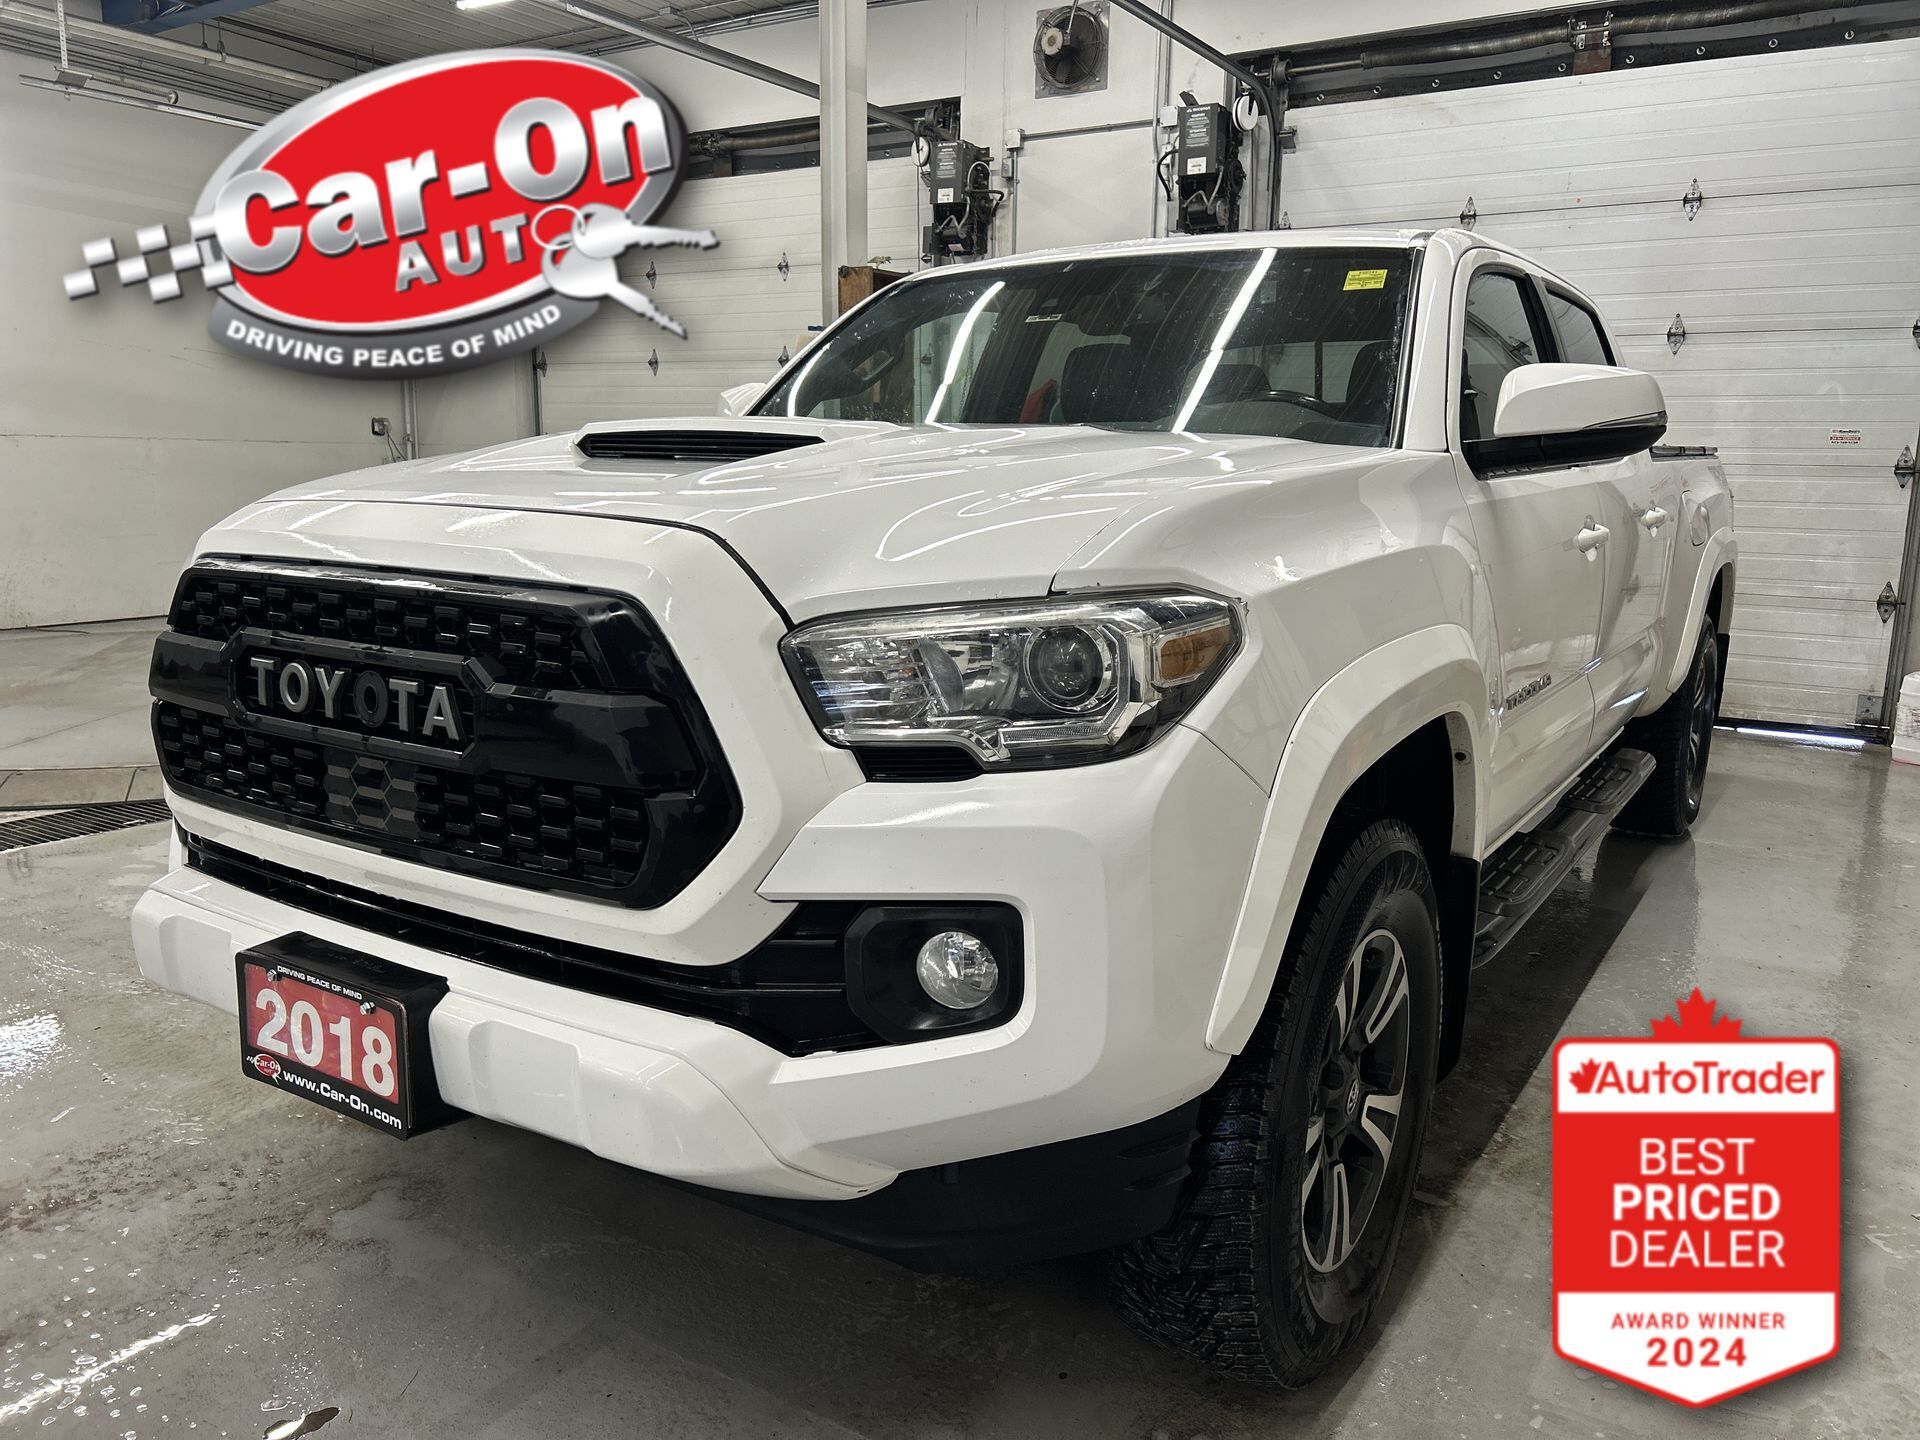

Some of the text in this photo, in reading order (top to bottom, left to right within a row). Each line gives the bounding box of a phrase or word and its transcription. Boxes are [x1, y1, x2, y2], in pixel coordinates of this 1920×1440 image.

[250, 656, 464, 741] TOYOTA
[277, 965, 363, 1001] DRIVING PEACE OF MIND
[254, 1056, 281, 1071] Car-On
[255, 988, 395, 1097] 2018
[283, 1070, 402, 1130] www.Car-On.com
